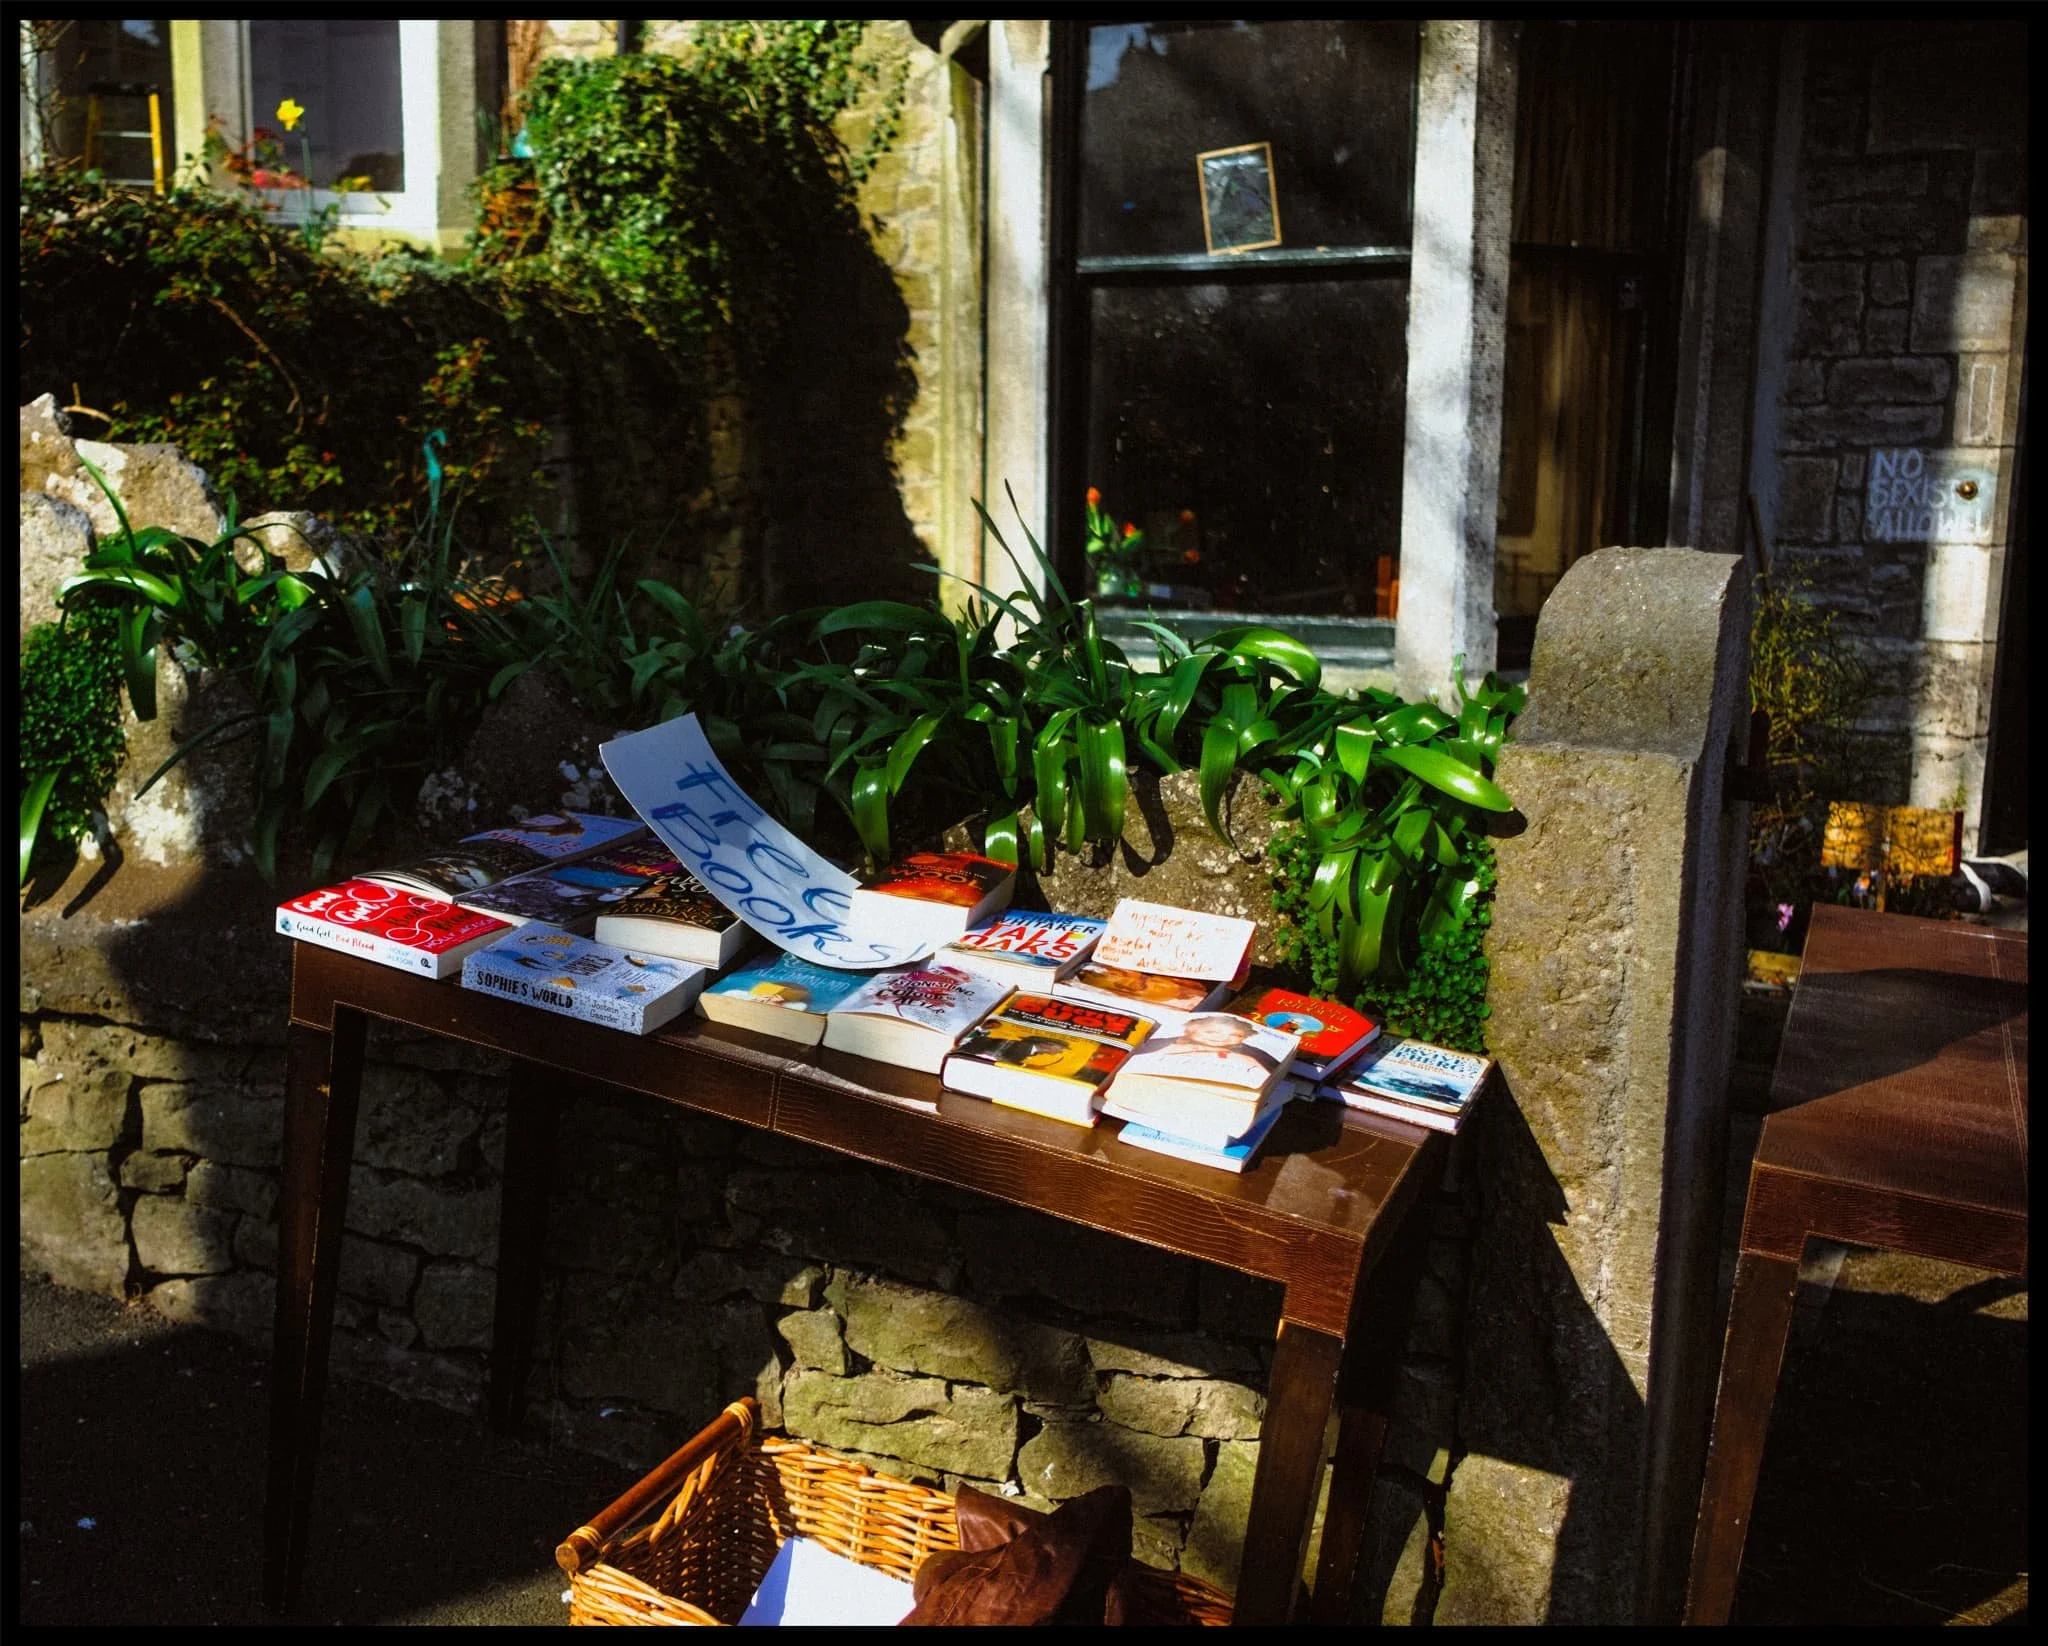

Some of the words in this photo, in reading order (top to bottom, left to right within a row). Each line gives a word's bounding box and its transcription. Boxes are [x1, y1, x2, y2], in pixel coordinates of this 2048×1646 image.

[1873, 448, 1923, 479] NO
[889, 868, 984, 890] WOOL
[975, 922, 1077, 946] TALL
[993, 917, 1098, 934] WHITAKER
[959, 934, 1078, 959] OAKS
[531, 986, 574, 1009] WORLD
[590, 999, 619, 1014] Jostein
[589, 1009, 619, 1025] Gaarder
